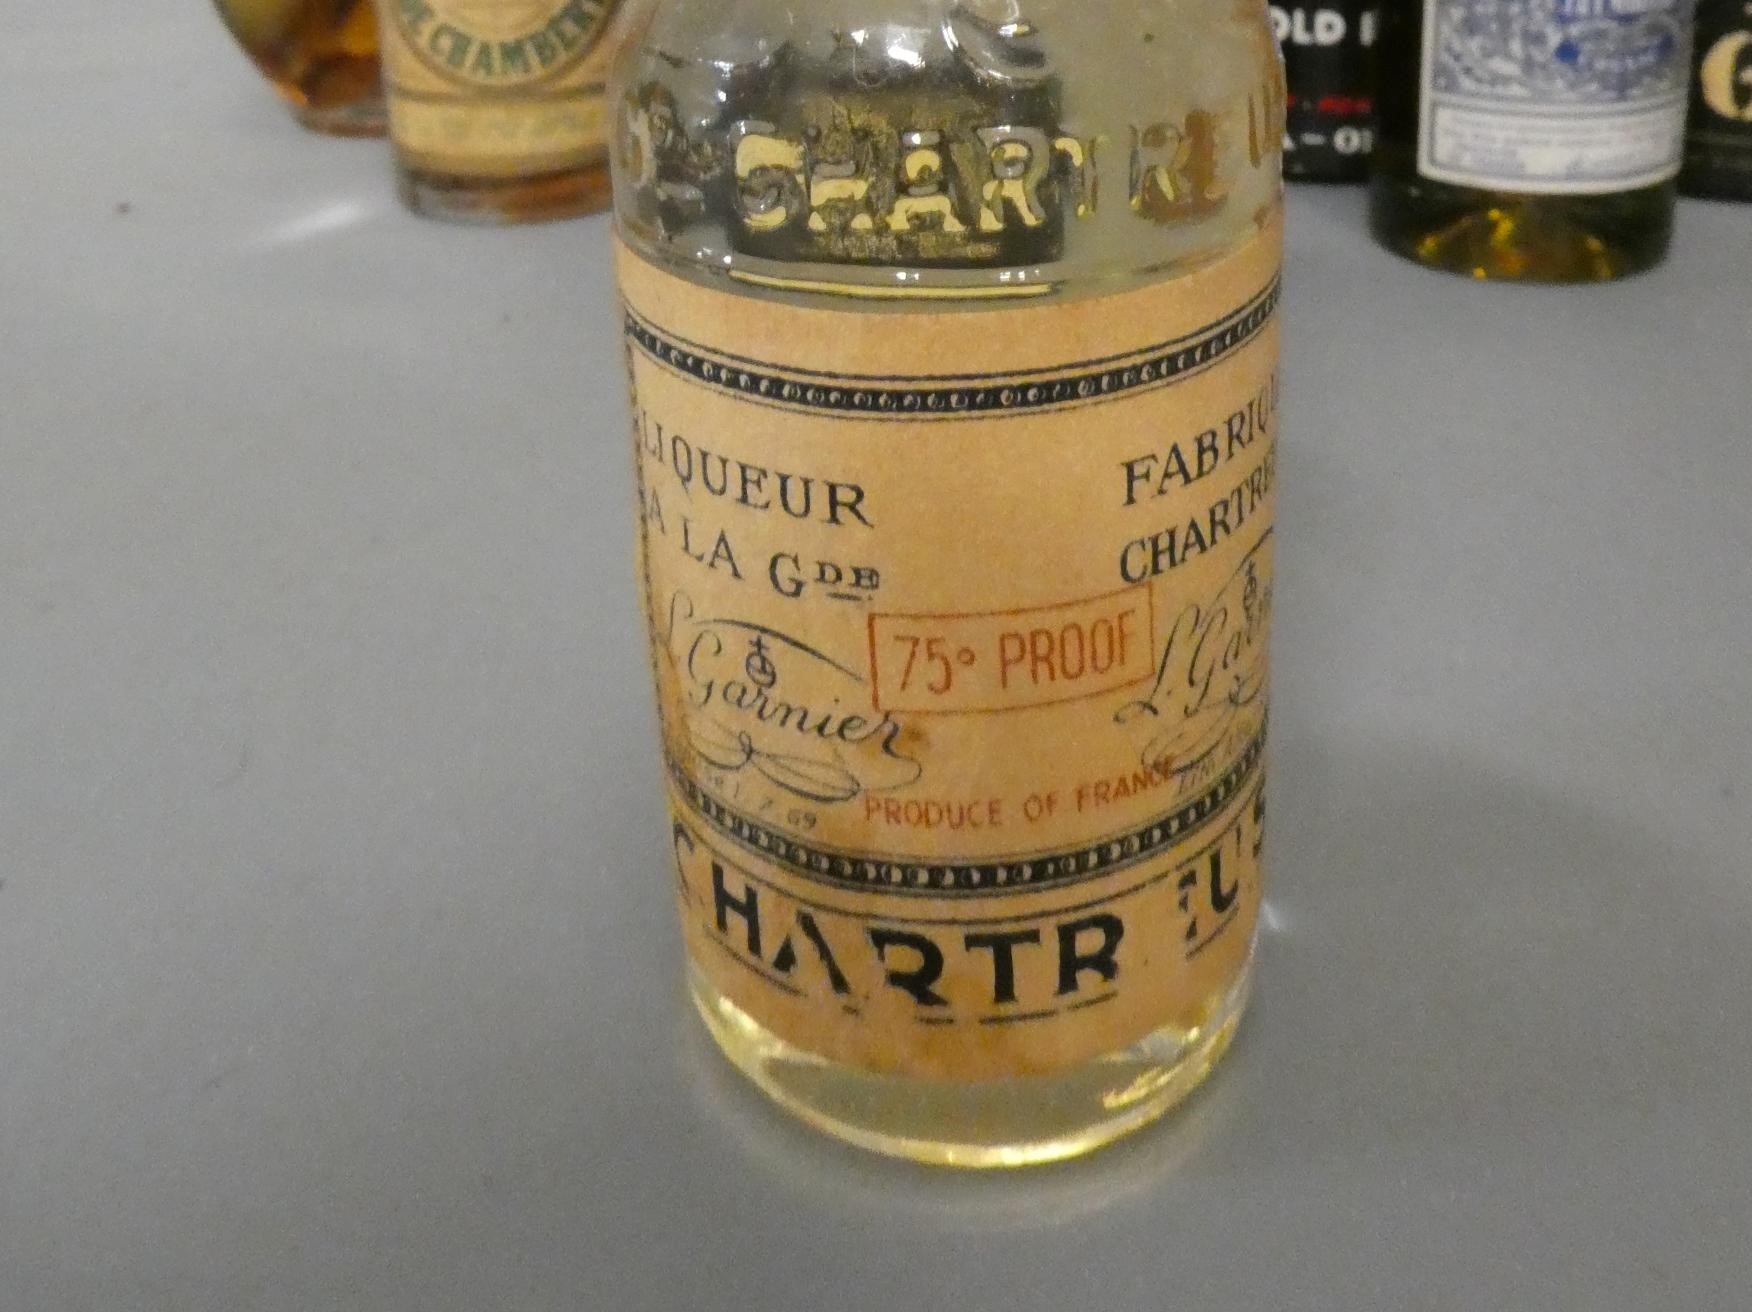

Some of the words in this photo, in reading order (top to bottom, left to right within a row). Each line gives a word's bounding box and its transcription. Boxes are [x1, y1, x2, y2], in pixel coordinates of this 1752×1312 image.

[642, 406, 875, 530] LIQUEUR
[681, 516, 745, 581] LA
[997, 608, 1137, 690] PROOF
[865, 789, 1003, 830] PRODUCE
[1022, 791, 1060, 824] OF
